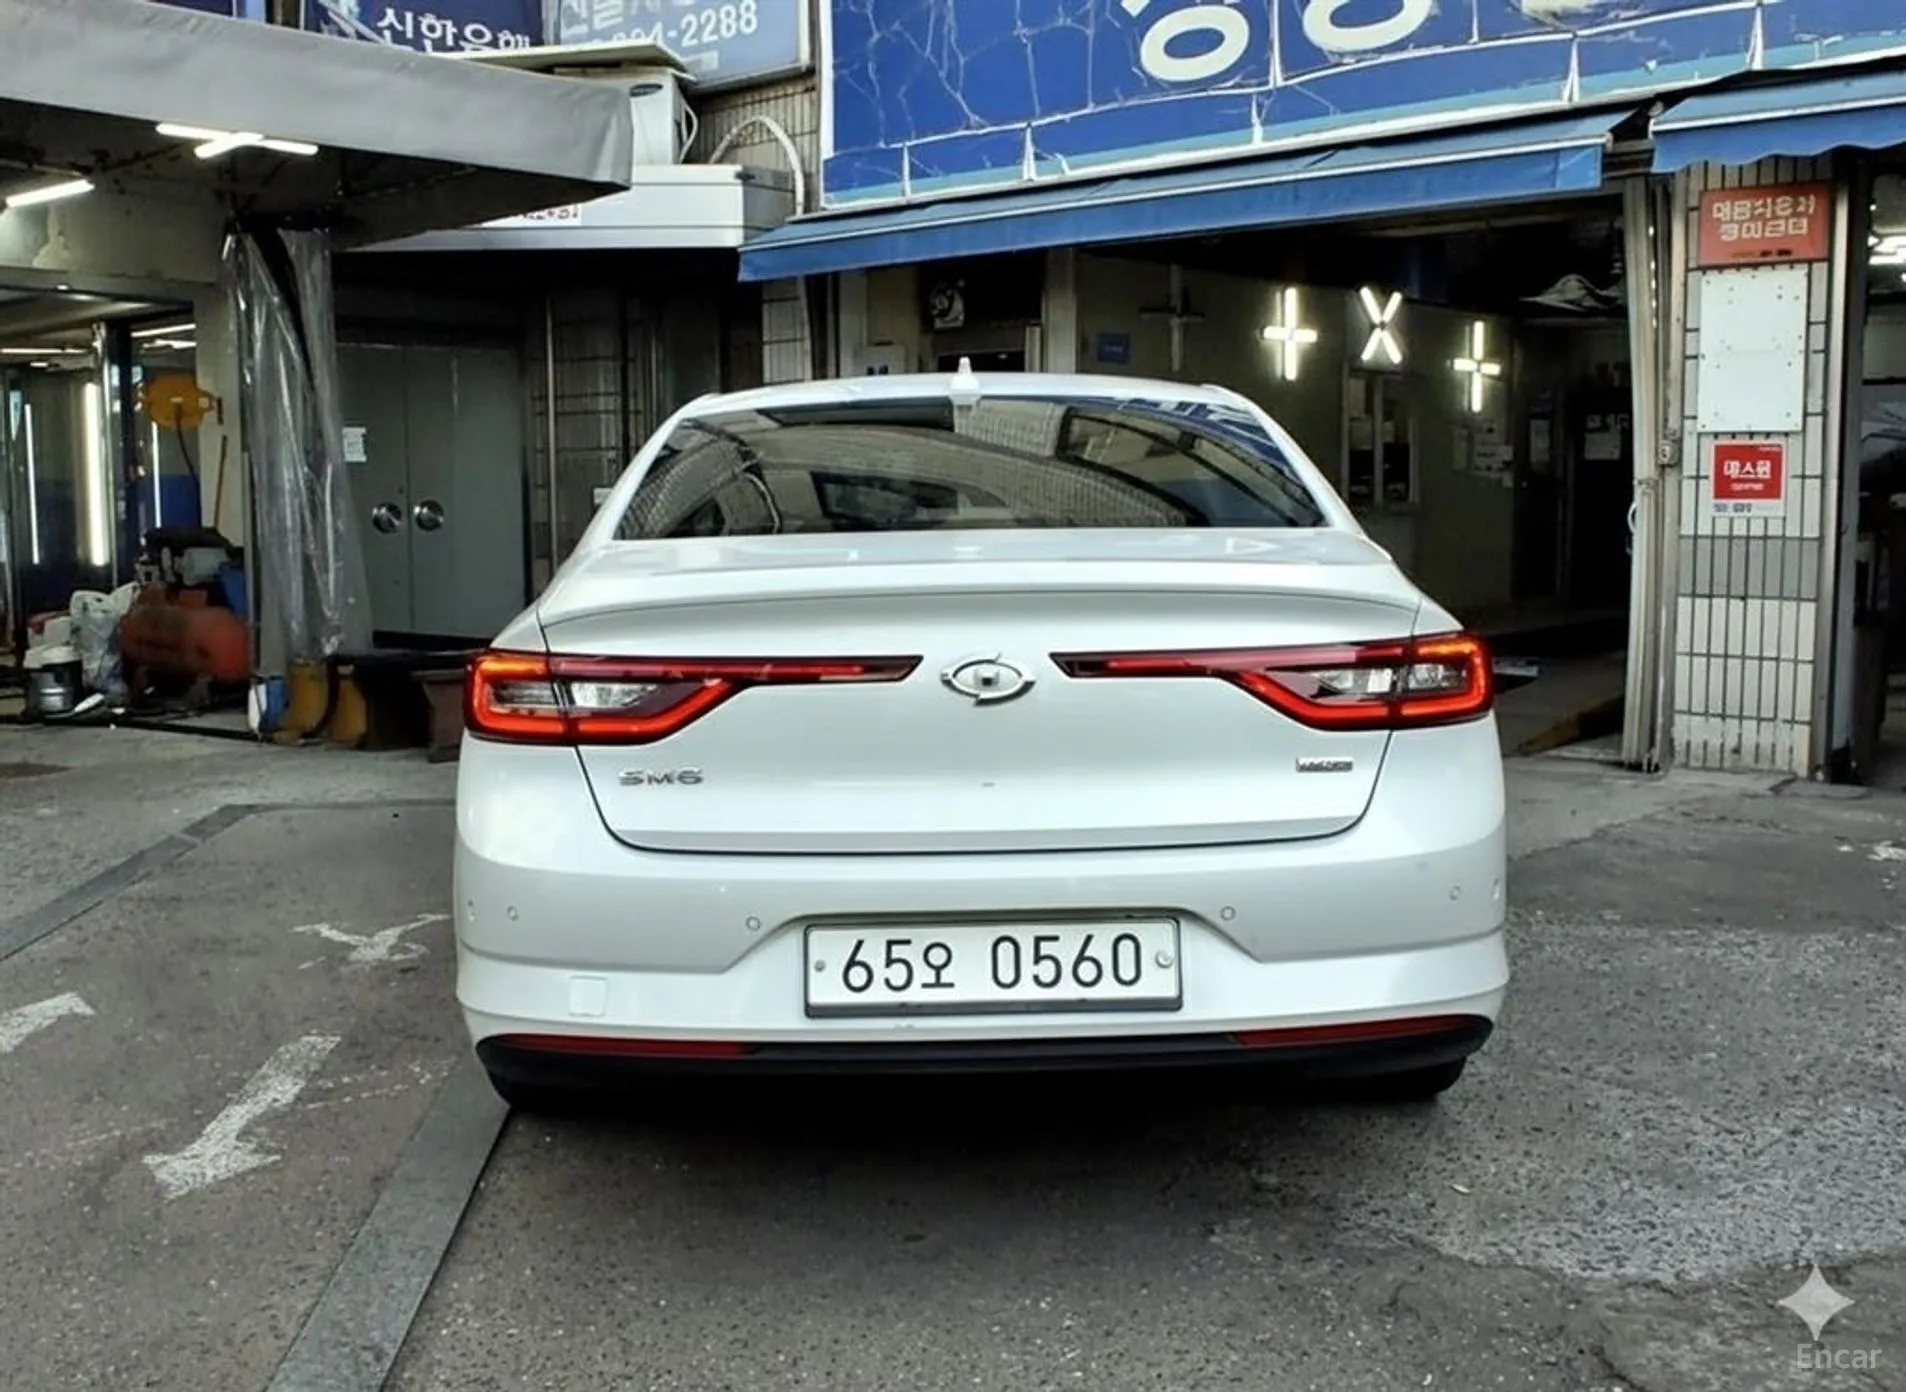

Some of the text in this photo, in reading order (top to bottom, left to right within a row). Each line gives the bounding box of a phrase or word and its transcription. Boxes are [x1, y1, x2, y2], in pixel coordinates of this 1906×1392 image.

[619, 769, 704, 787] SM6
[842, 932, 1142, 993] 65오 0560
